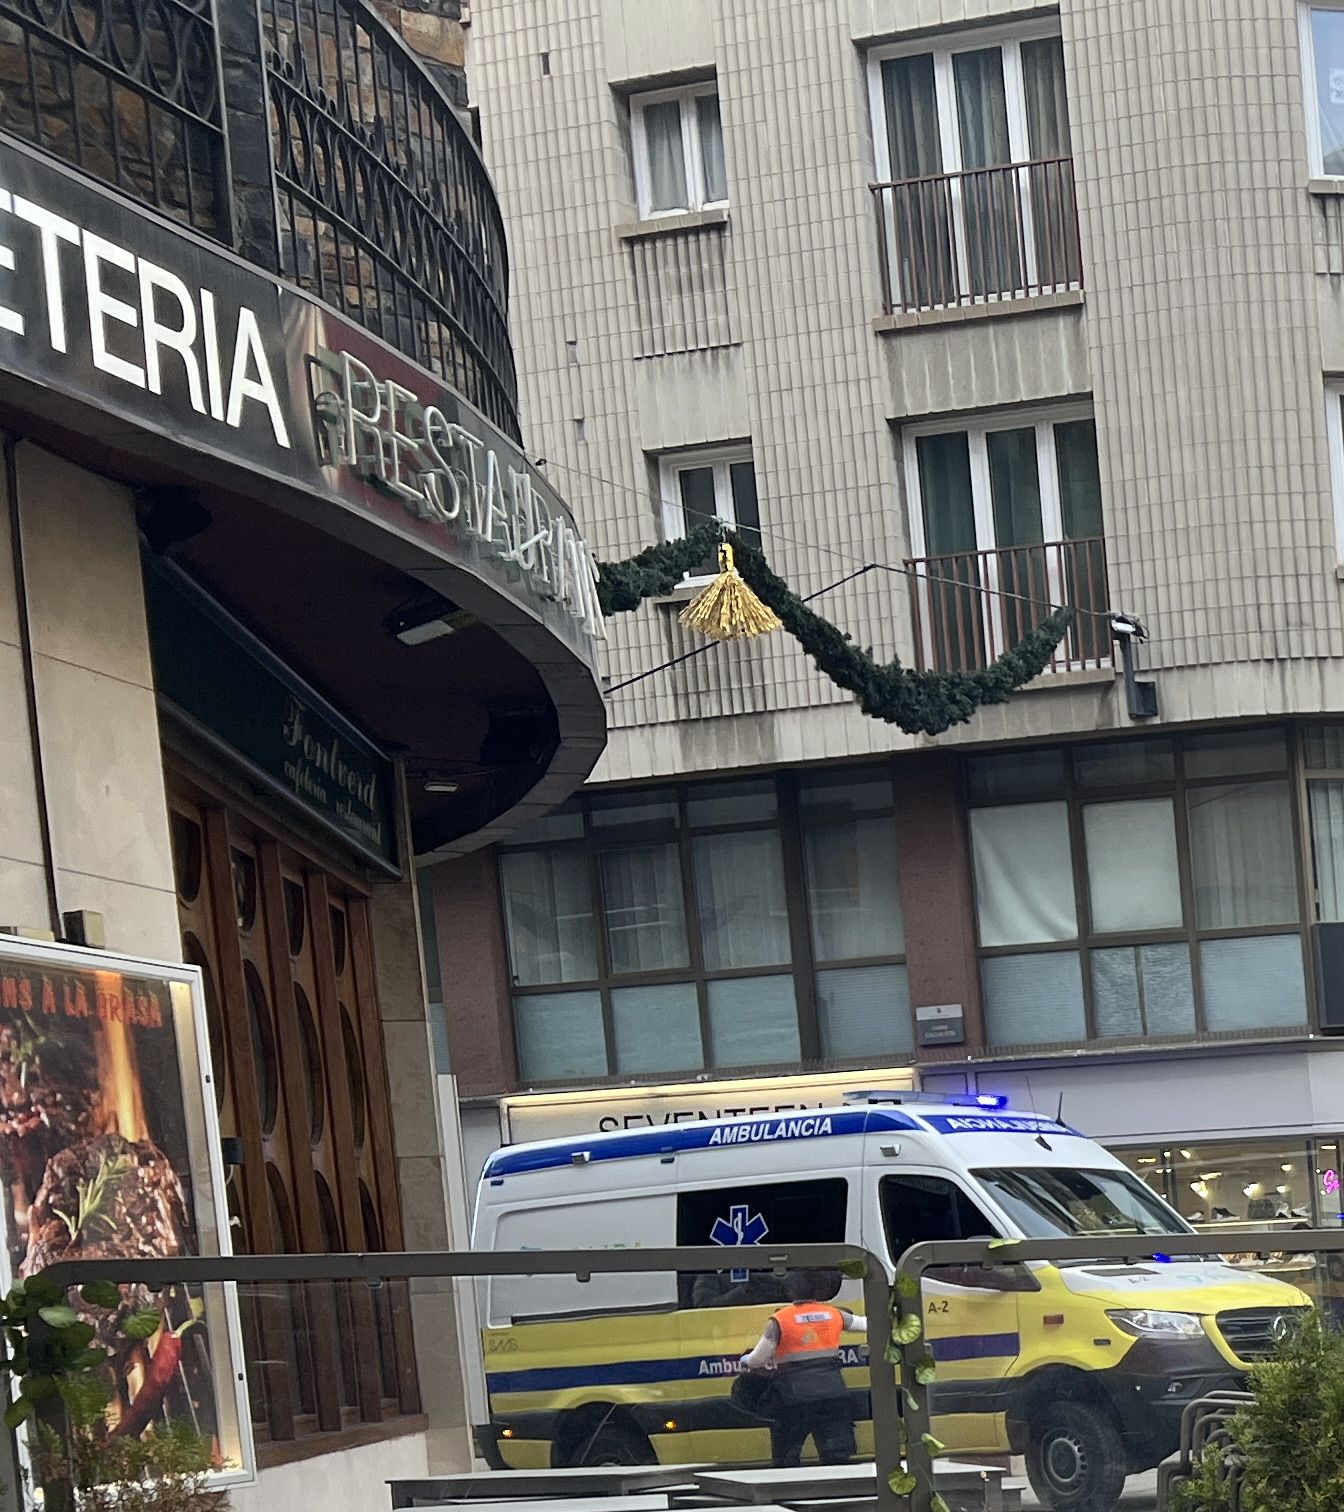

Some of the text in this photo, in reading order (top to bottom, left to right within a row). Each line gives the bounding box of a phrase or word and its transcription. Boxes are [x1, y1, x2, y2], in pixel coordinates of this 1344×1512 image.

[0, 187, 291, 449] TERIA
[709, 1117, 832, 1145] AMBULÀNCIA
[928, 1301, 950, 1314] A-2
